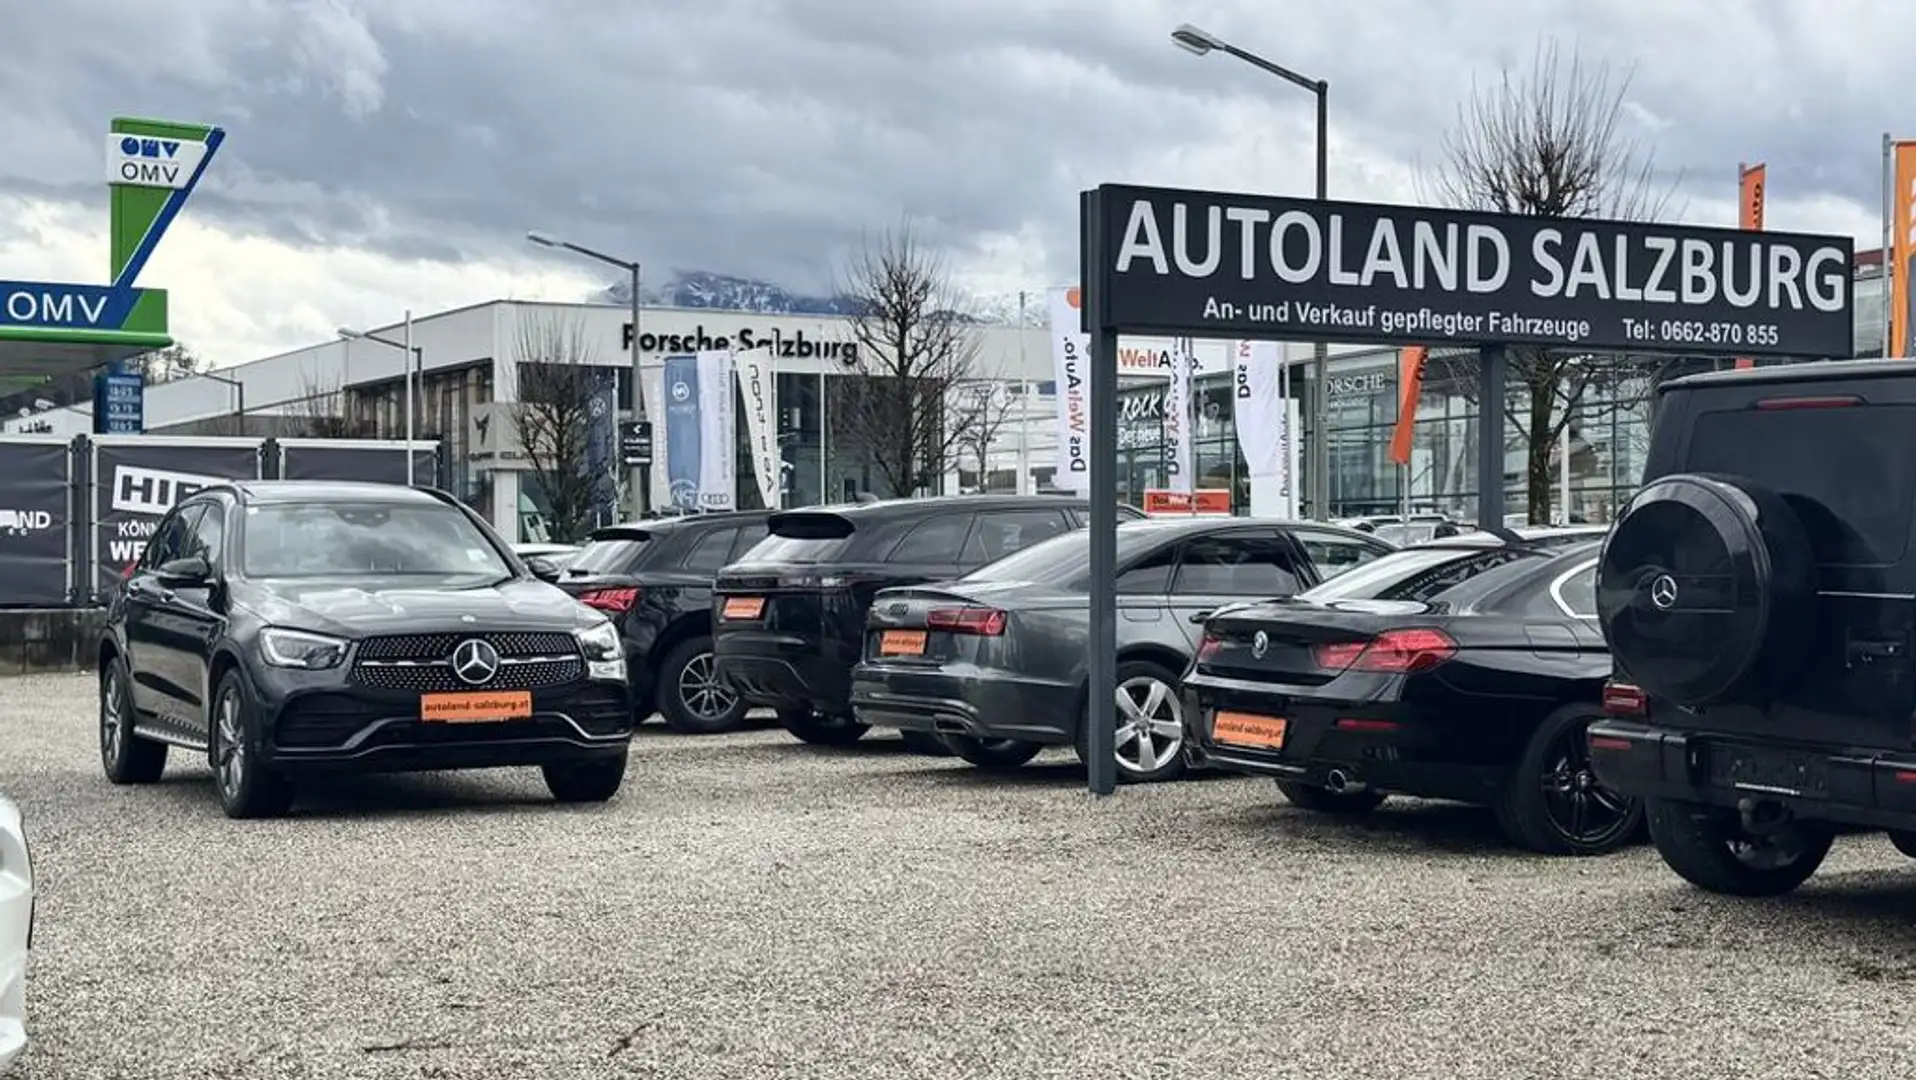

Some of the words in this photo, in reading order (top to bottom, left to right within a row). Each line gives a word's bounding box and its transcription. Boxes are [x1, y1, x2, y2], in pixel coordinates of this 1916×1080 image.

[121, 162, 180, 183] OMV
[1115, 199, 1512, 294] AUTOLAND
[1530, 228, 1847, 312] SALZBURG
[7, 291, 108, 324] OMV
[1203, 297, 1243, 321] An-
[1248, 302, 1289, 323] und
[1298, 302, 1376, 328] Verkauf
[1380, 307, 1483, 336] gepflegter
[1488, 311, 1590, 342] Fahrzeuge
[1623, 318, 1655, 341] Tel:
[1661, 320, 1742, 344] 0662-870
[1747, 325, 1779, 346] 855
[1119, 350, 1204, 370] WeltAo.
[1325, 372, 1385, 395] ORSCHE
[1121, 393, 1160, 421] ROCK
[110, 541, 147, 562] WE
